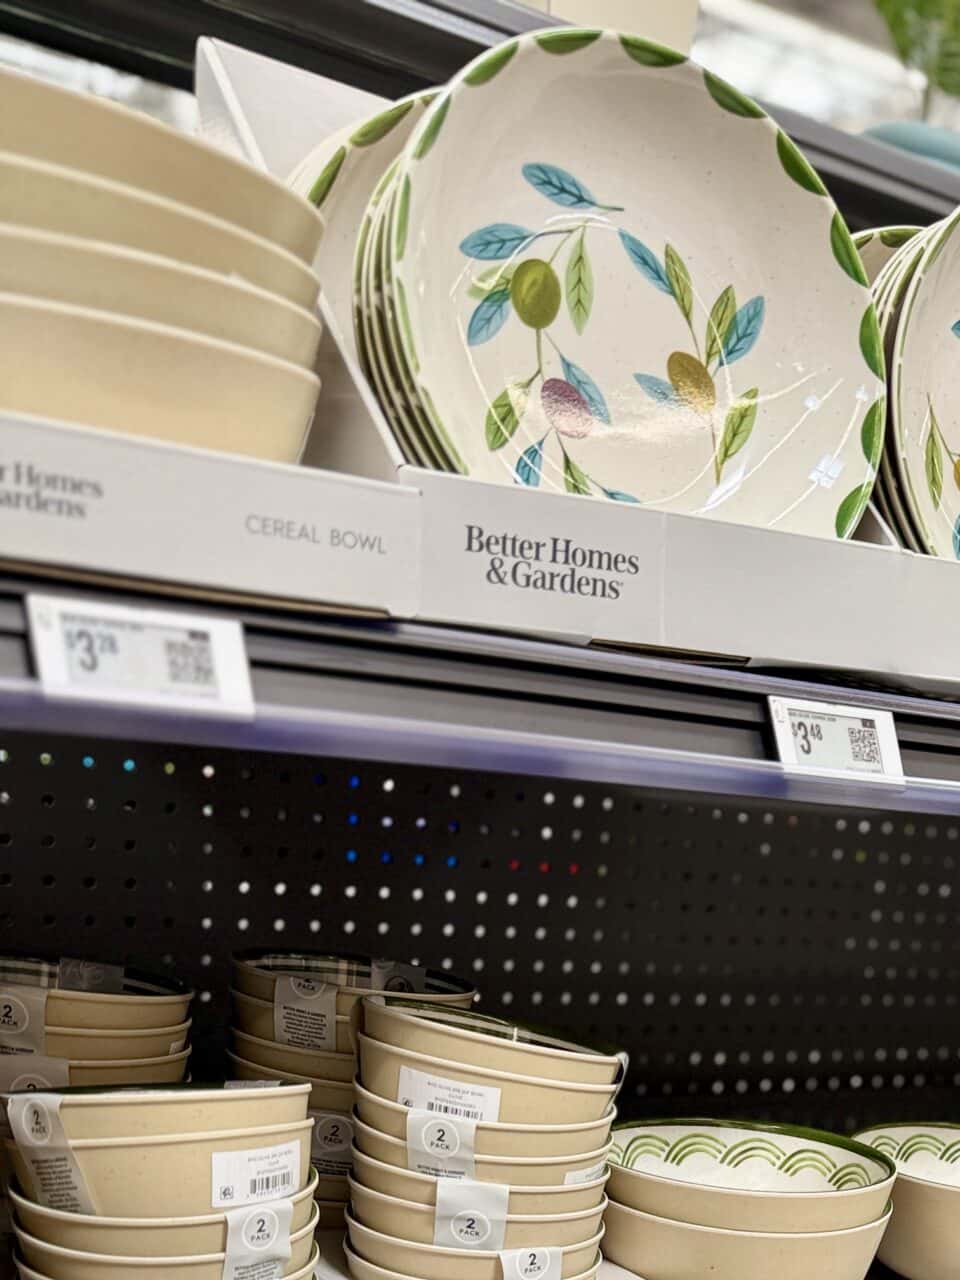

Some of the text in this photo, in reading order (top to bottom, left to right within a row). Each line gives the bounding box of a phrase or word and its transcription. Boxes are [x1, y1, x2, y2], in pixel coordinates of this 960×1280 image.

[0, 490, 87, 519] ardens
[246, 514, 387, 555] CEREAL BOWL
[465, 524, 639, 575] Better Homes
[2, 1004, 12, 1018] 2
[34, 1110, 40, 1125] 2
[331, 1125, 339, 1137] 2
[436, 1129, 446, 1142] 2
[430, 1142, 450, 1151] PACK
[257, 1218, 266, 1232] 2
[466, 1218, 476, 1229] 2
[251, 1233, 271, 1242] PACK
[459, 1228, 480, 1237] PACK
[528, 1253, 537, 1266] 2
[524, 1266, 541, 1274] PACK
